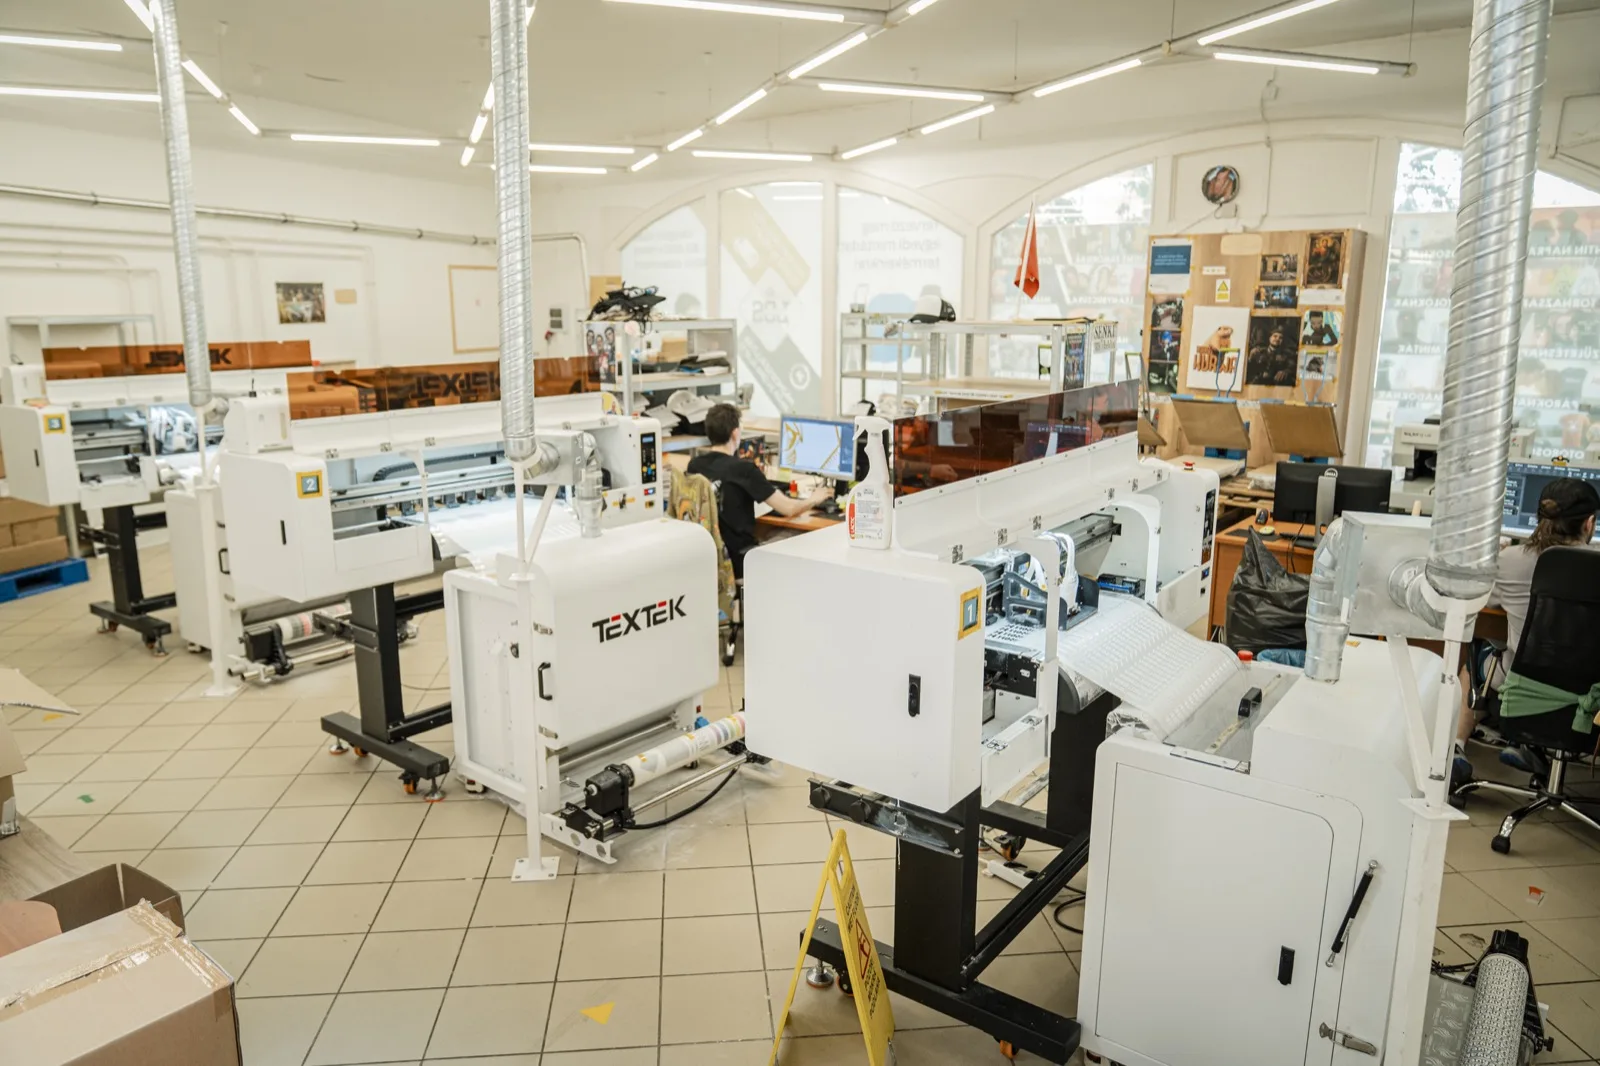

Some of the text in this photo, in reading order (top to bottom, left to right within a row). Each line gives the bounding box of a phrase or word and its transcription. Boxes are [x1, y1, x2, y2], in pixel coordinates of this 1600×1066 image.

[306, 478, 315, 490] 2
[592, 594, 687, 643] TEXTEK
[967, 603, 973, 623] 1
